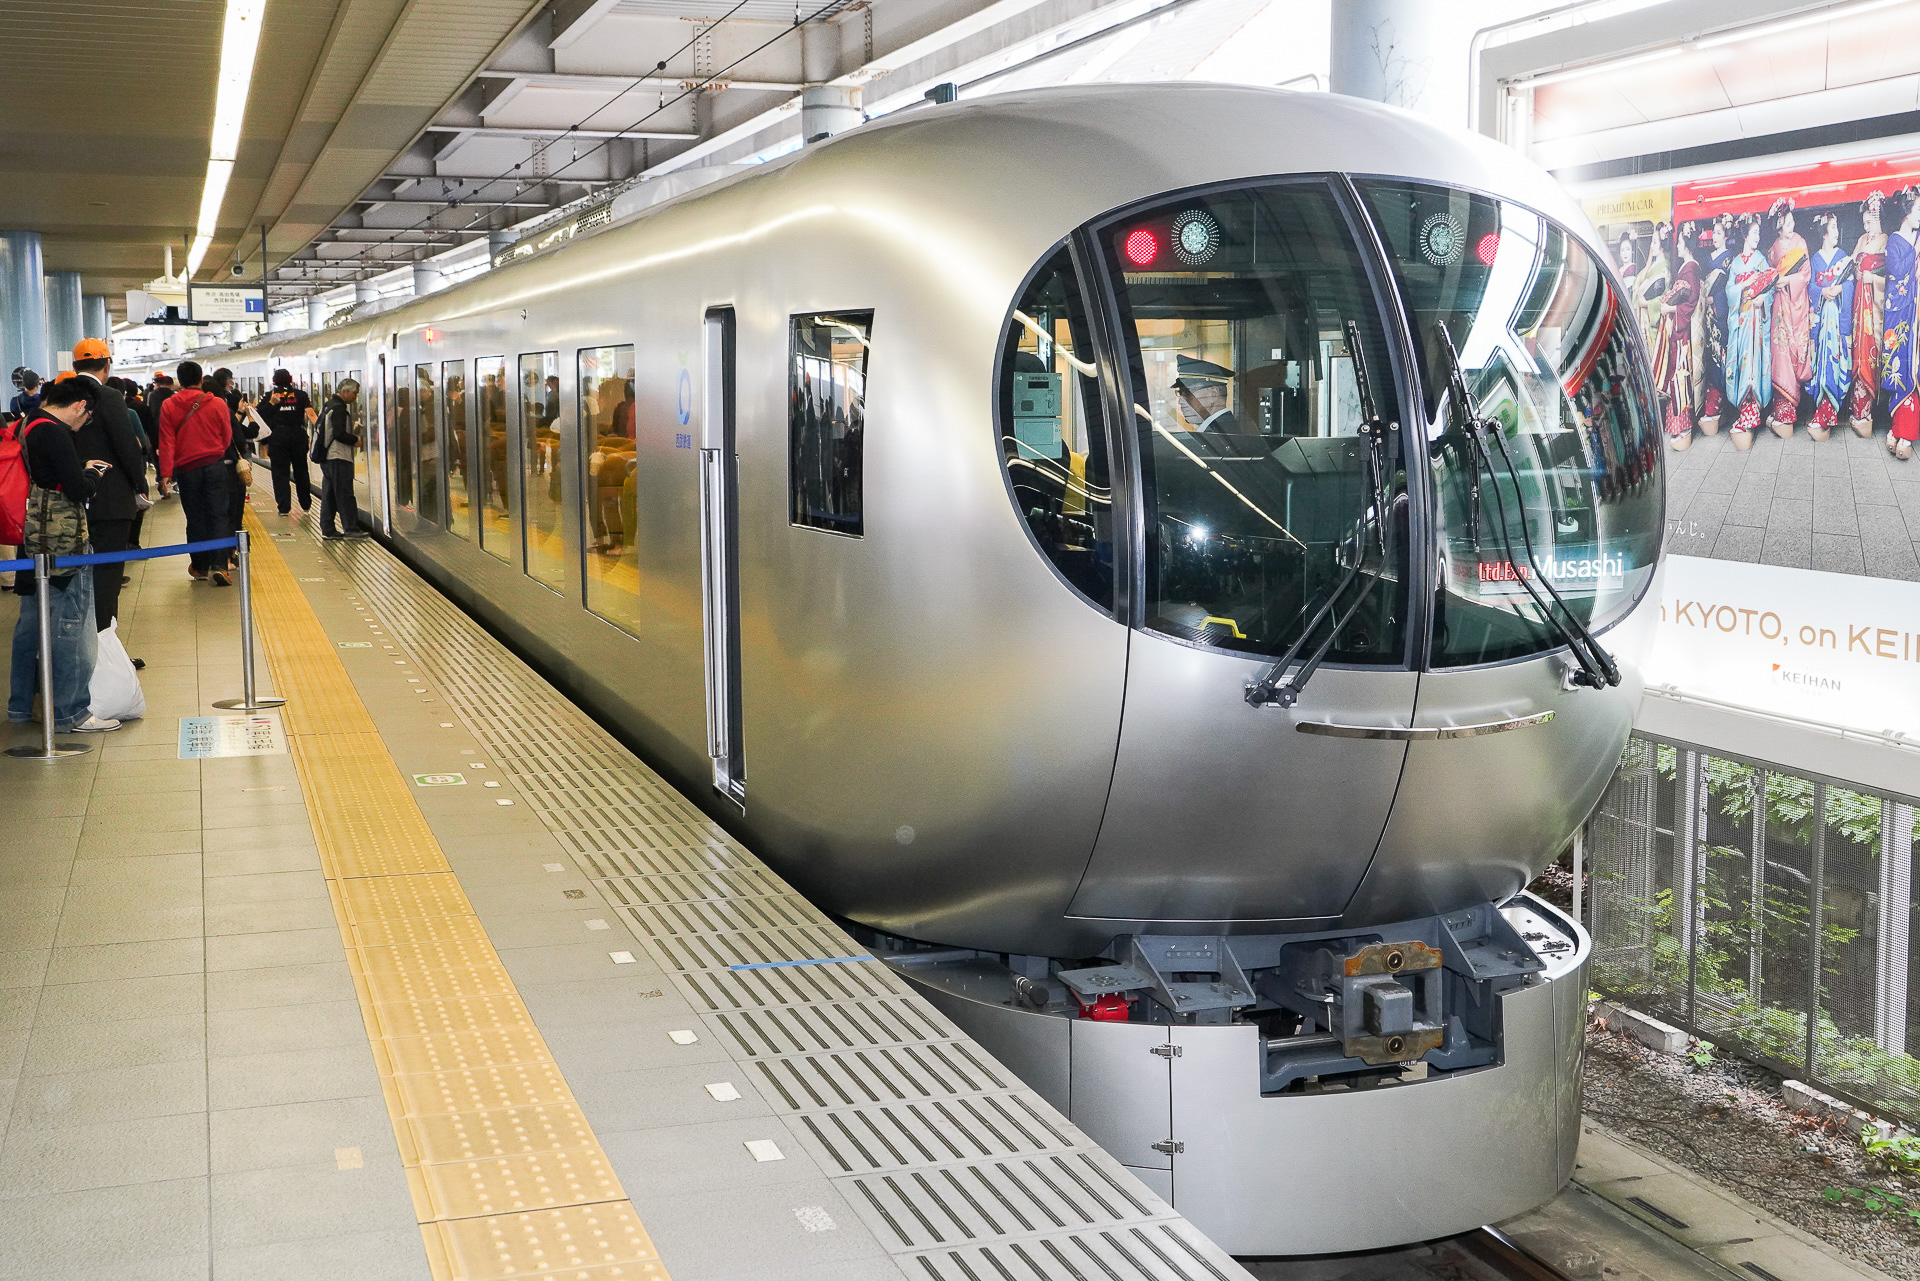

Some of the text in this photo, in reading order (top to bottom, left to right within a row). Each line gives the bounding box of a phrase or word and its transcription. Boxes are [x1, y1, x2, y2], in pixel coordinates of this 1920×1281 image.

[1597, 199, 1654, 215] PREMIUM CAR
[248, 300, 254, 312] 1
[1531, 552, 1623, 580] Musashi
[1675, 599, 1789, 647] KYOTO,
[1799, 625, 1837, 649] on
[1848, 624, 1920, 663] KEI
[1782, 671, 1842, 691] KEIHAN
